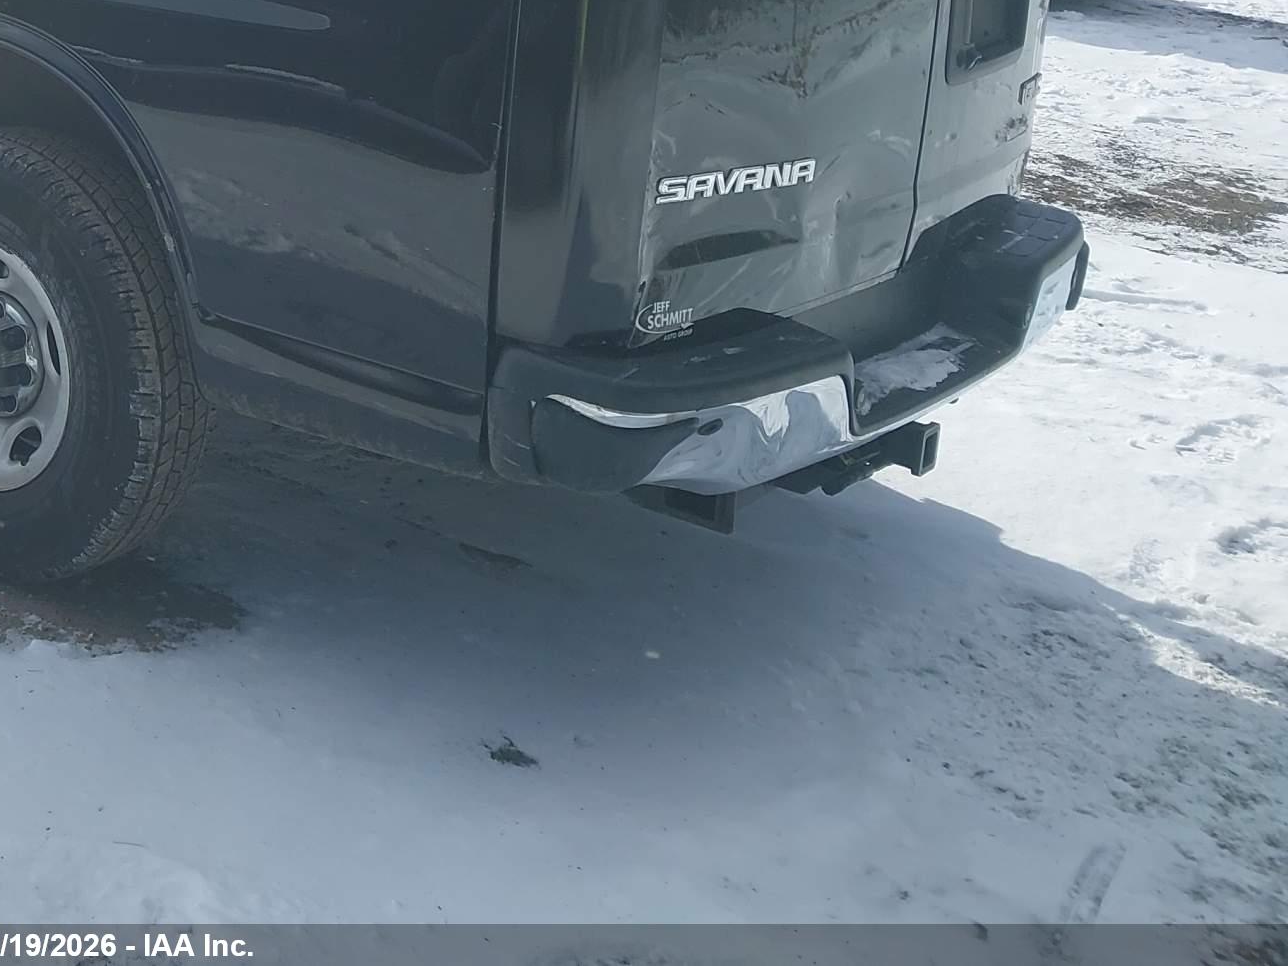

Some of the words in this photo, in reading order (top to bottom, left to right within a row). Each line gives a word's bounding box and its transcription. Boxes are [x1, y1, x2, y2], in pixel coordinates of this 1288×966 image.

[655, 157, 817, 205] SAVANA
[647, 307, 694, 330] SCHMITT
[652, 300, 671, 314] JEFF
